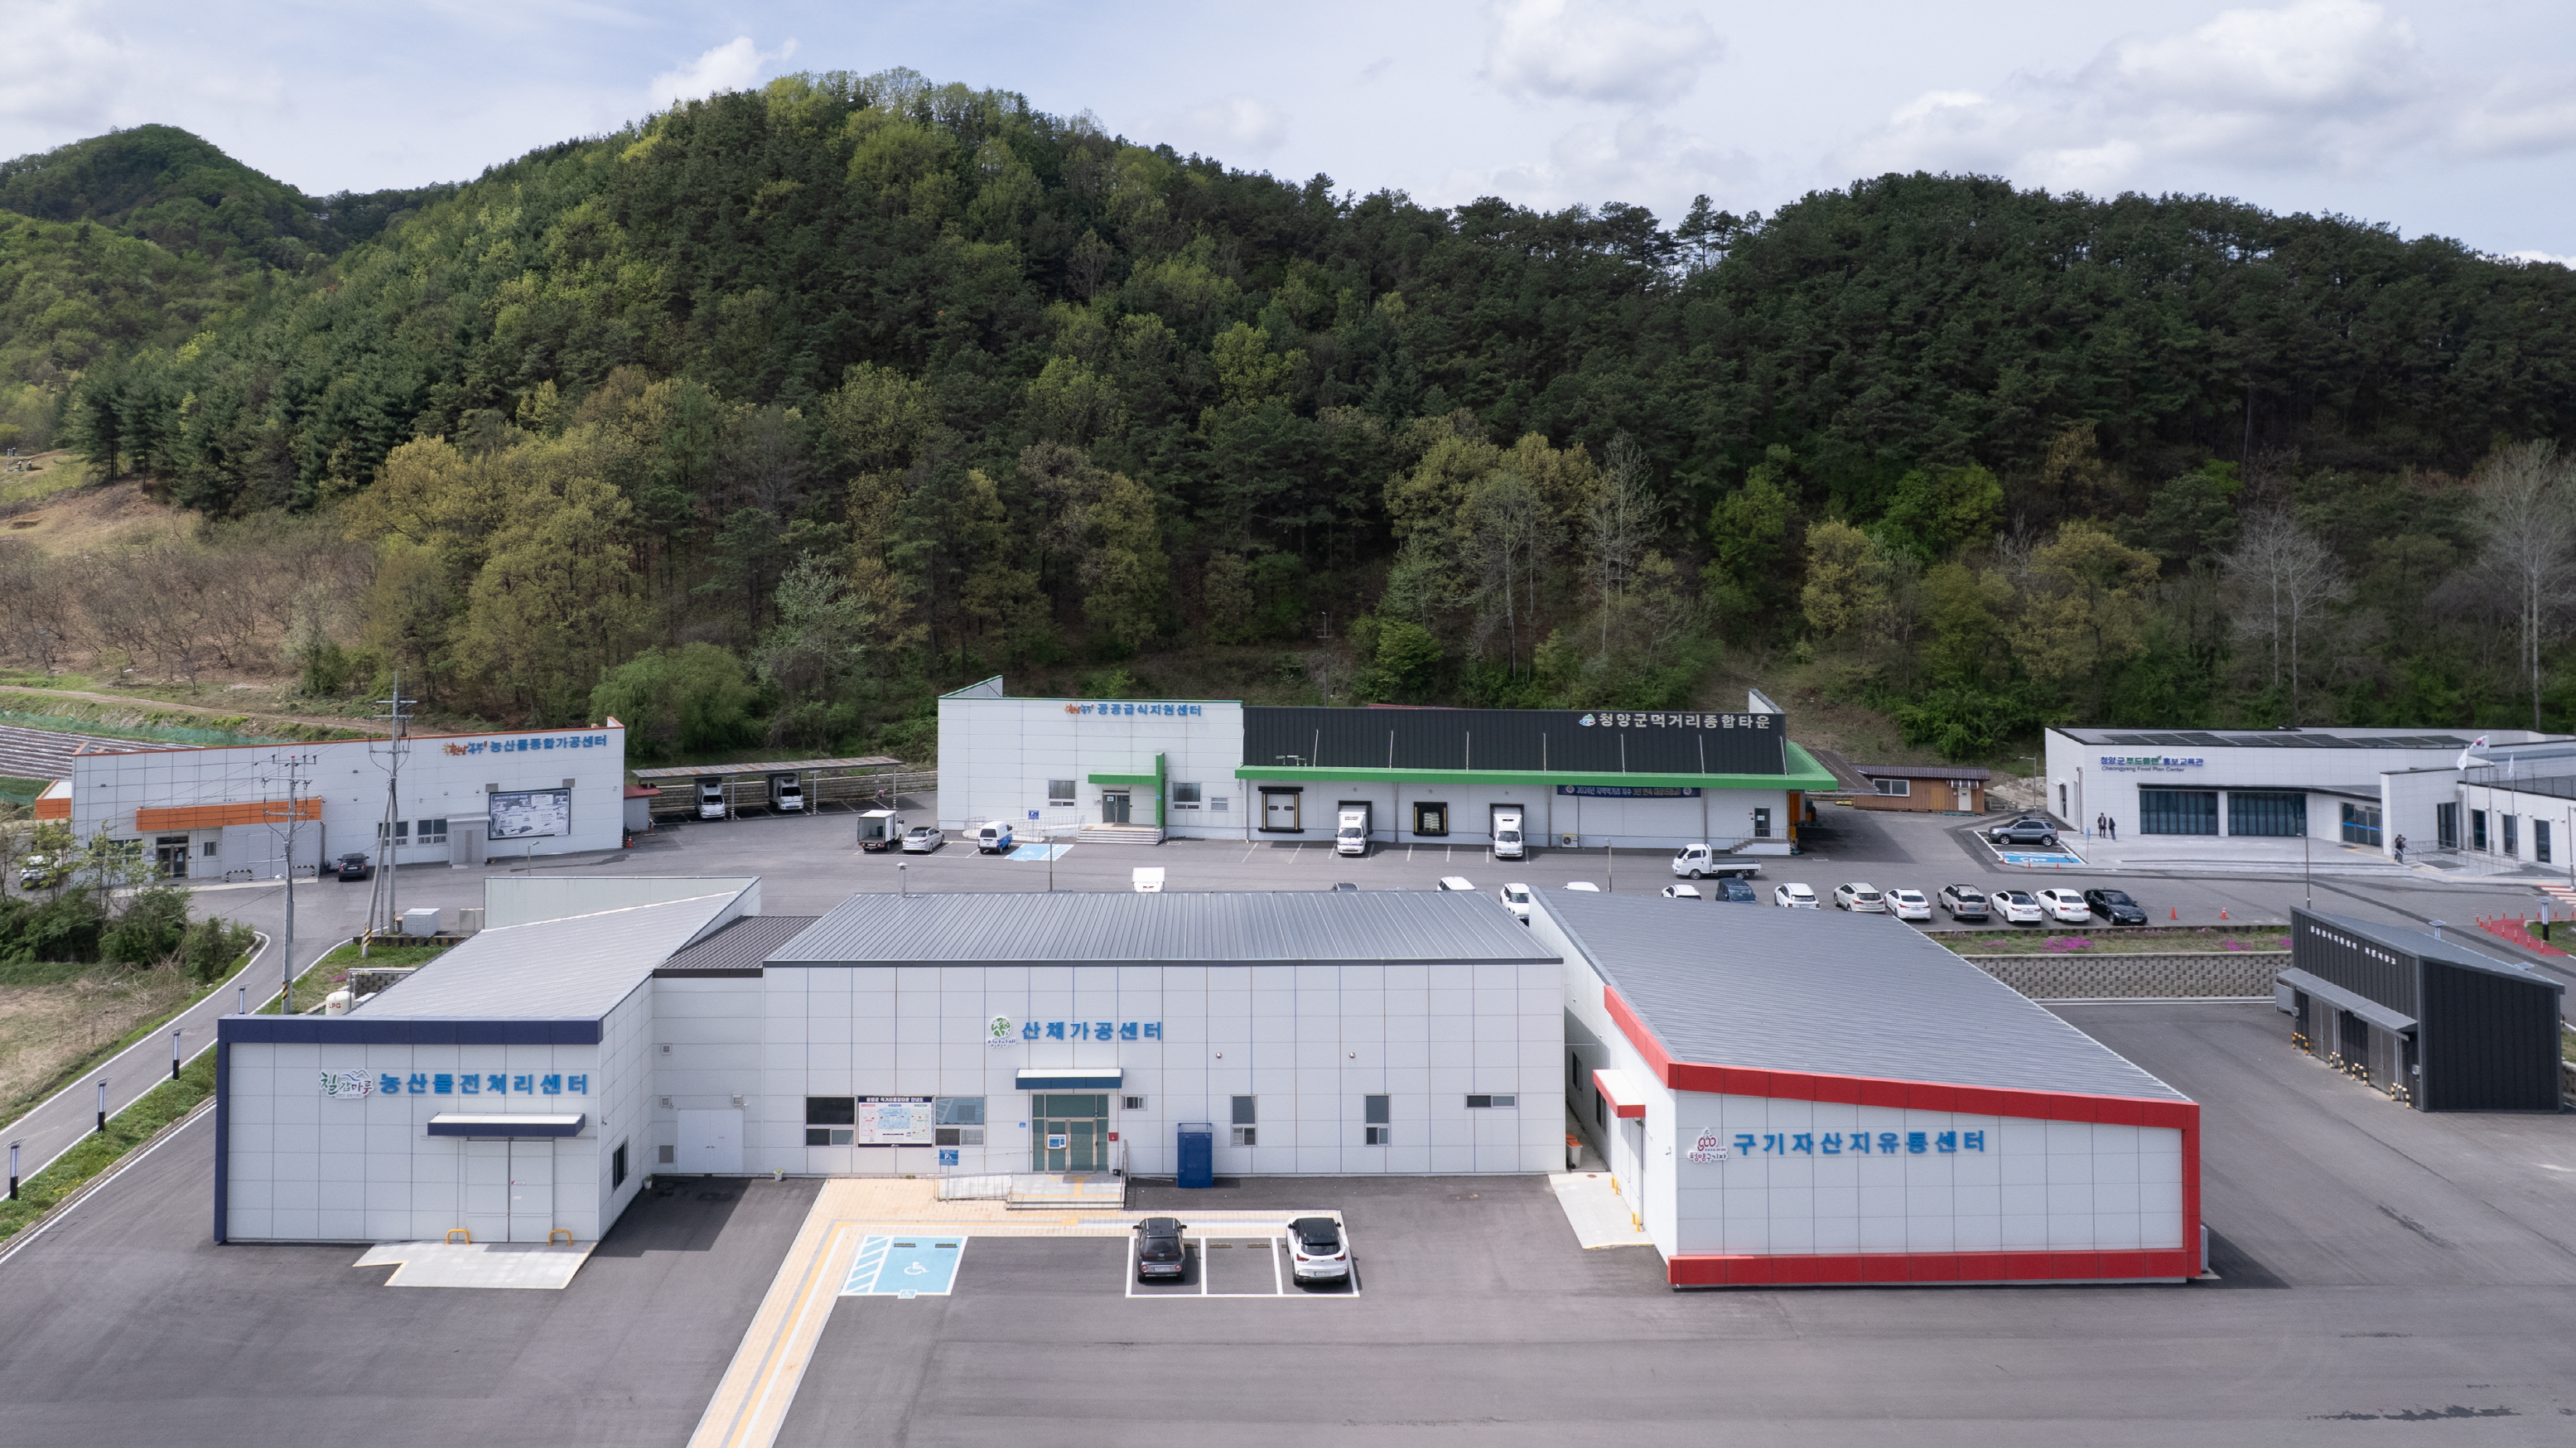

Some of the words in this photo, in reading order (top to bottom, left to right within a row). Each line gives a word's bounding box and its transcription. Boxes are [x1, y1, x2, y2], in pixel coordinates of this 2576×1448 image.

[1097, 703, 1201, 717] 공공급식지원센터
[1599, 713, 1770, 729] 청양군먹거리종합타운
[490, 735, 607, 753] 농산물종합가공센터
[1022, 1021, 1162, 1040] 산채가공센터
[321, 1072, 374, 1094] 칠갑마루
[379, 1073, 588, 1095] 농산물전처리센터
[1734, 1130, 1985, 1156] 구기자산지유통센터
[1690, 1152, 1727, 1162] 청양구기자
